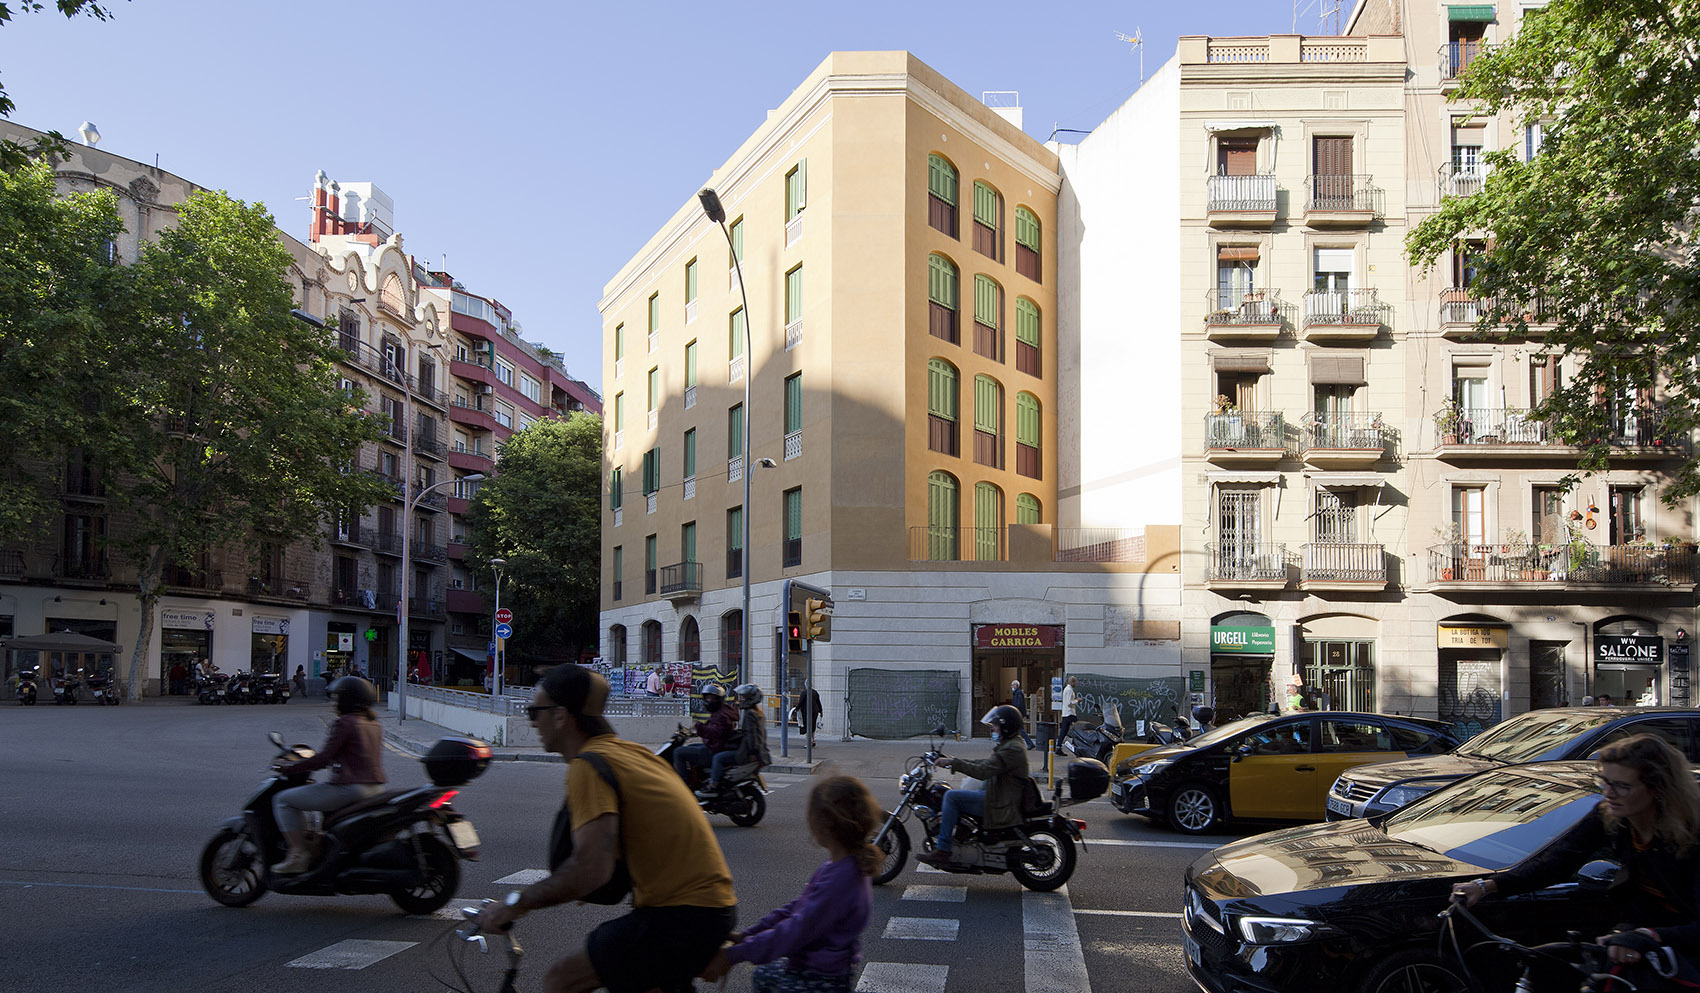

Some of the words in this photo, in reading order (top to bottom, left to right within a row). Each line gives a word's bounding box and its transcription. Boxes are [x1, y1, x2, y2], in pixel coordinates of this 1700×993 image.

[994, 628, 1038, 636] MOBLES
[990, 637, 1043, 647] GARRIGA
[1214, 632, 1248, 645] URGELL
[1599, 644, 1658, 657] SALONE
